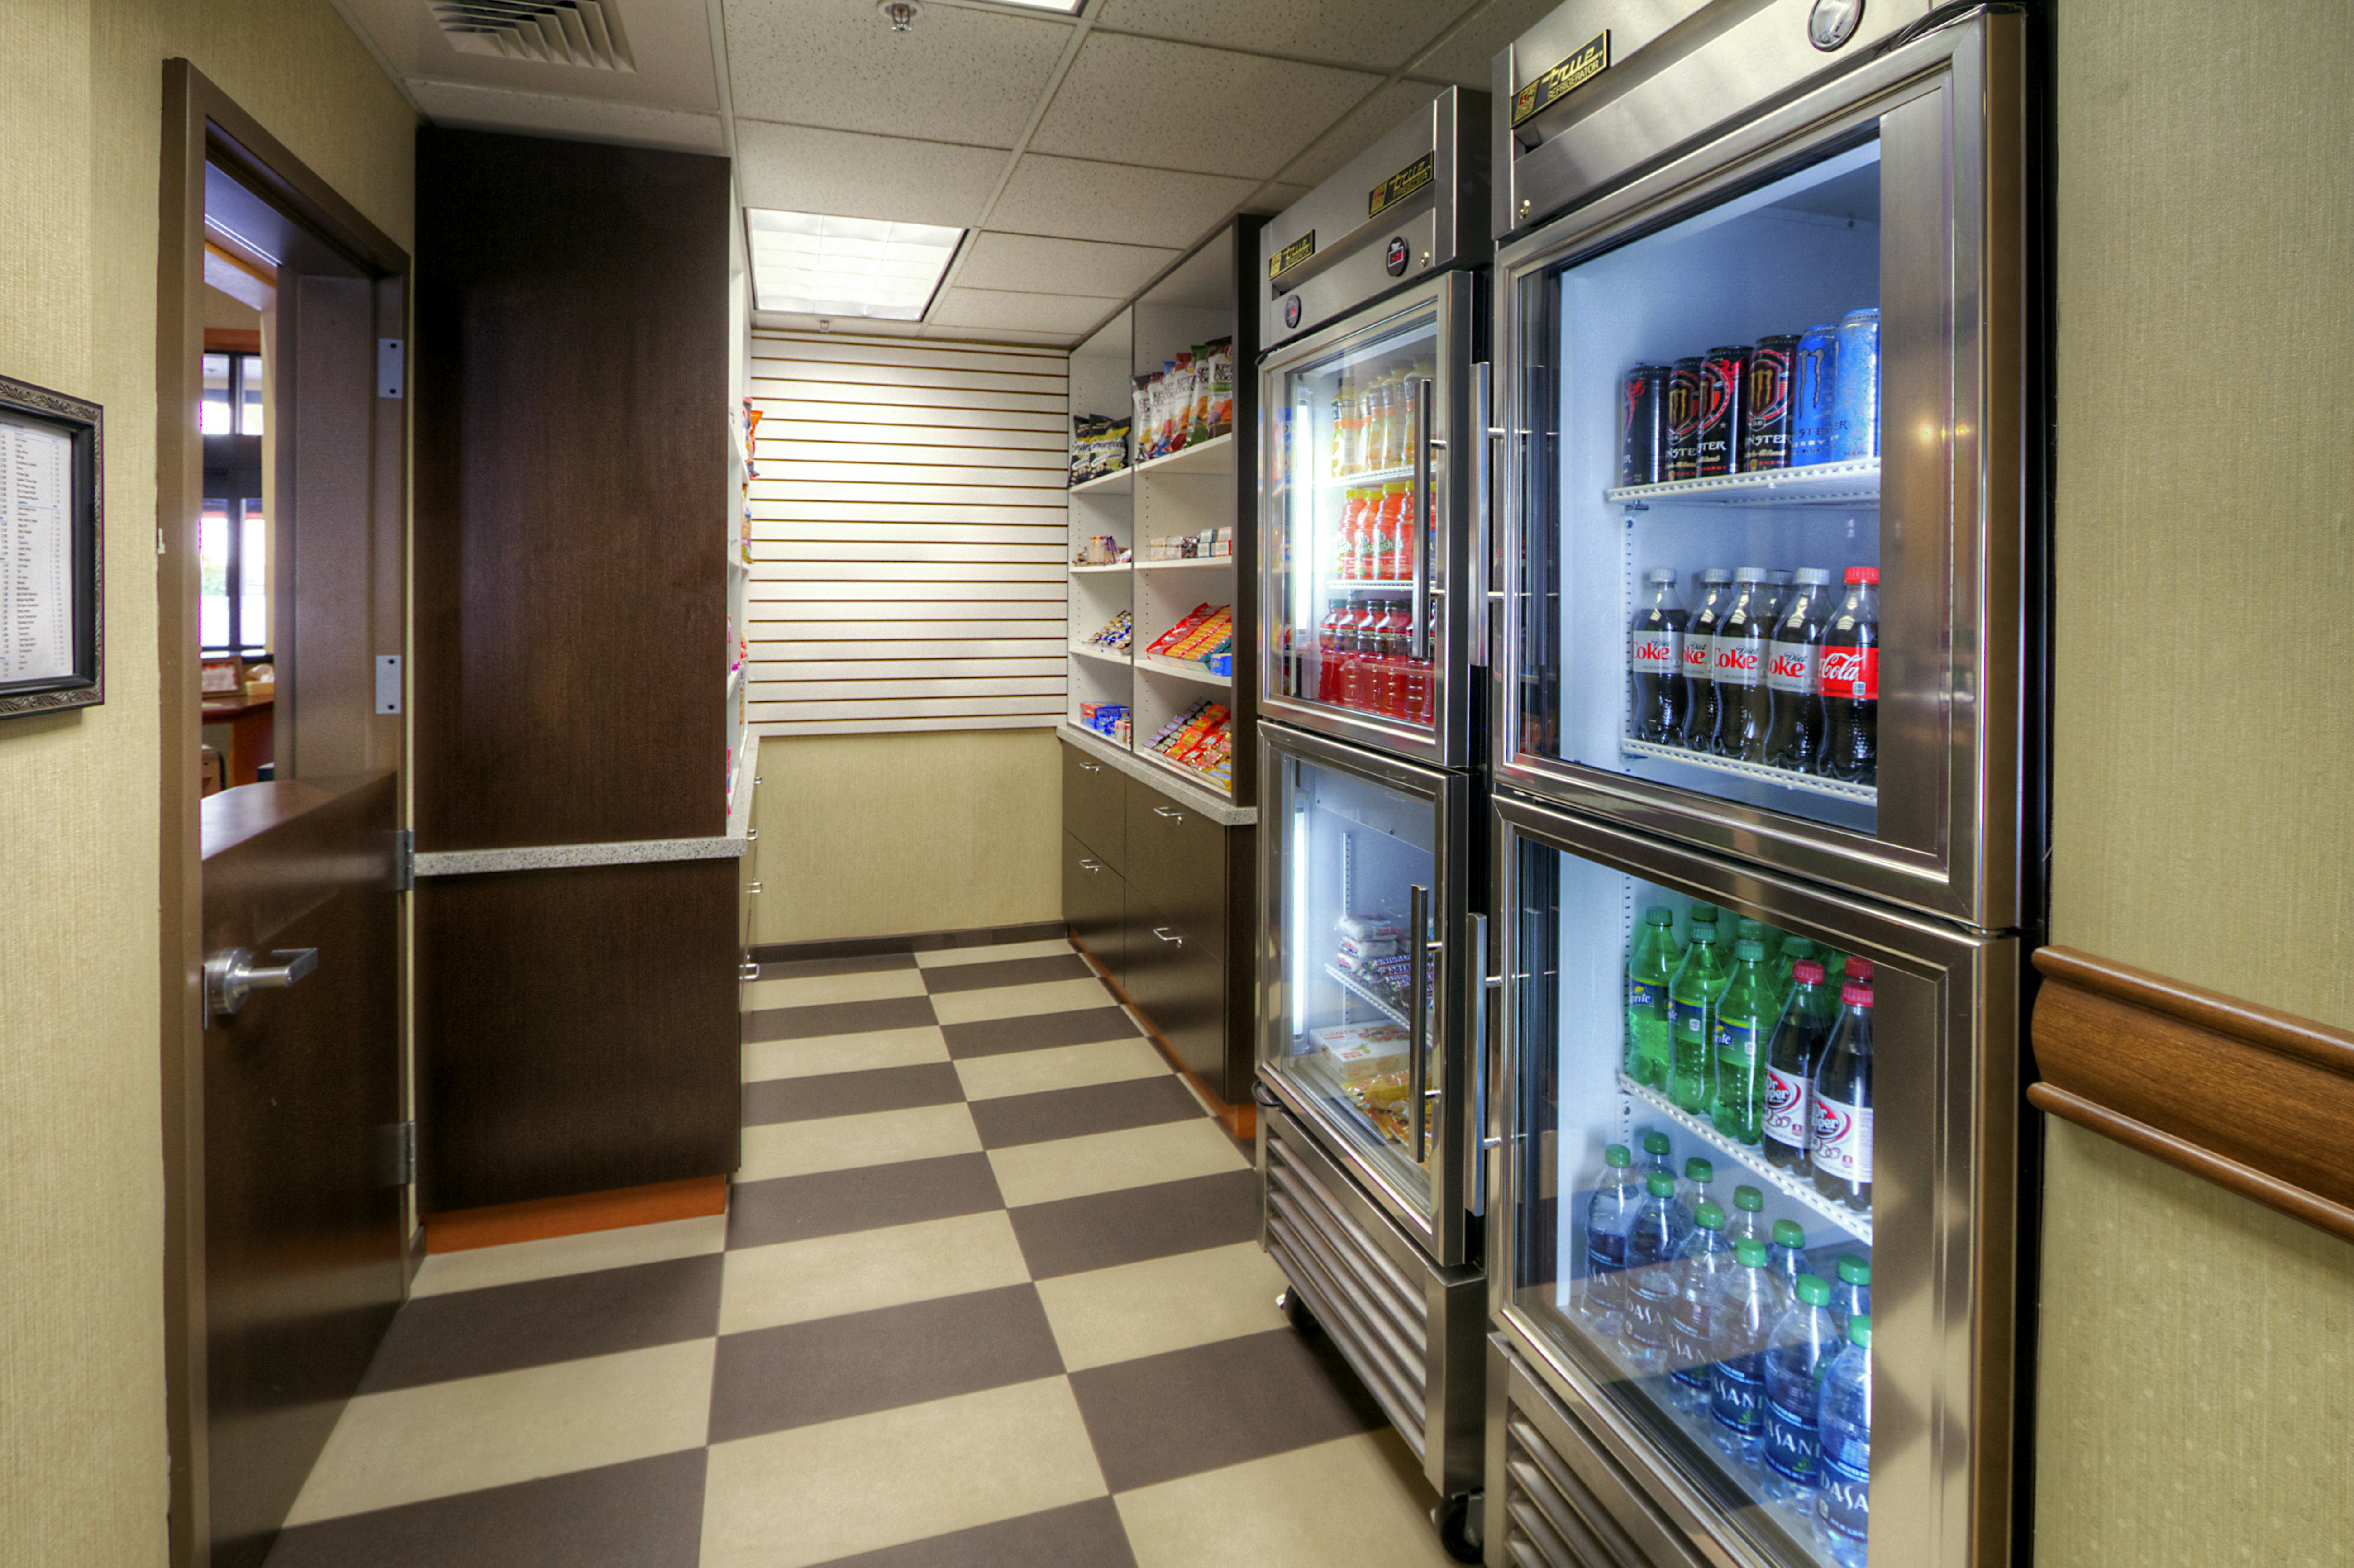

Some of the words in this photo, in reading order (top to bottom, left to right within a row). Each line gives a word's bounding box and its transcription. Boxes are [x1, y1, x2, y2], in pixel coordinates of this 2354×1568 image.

[1542, 46, 1599, 91] true
[1548, 59, 1599, 100] REFRIGERATOR
[1698, 441, 1726, 453] STER
[1745, 434, 1792, 447] NSTER
[1665, 447, 1696, 458] NSTE
[1714, 647, 1758, 670] Coke
[1769, 655, 1806, 678] oke
[1822, 653, 1866, 681] Cola
[1766, 1089, 1790, 1103] pper
[1820, 1470, 1869, 1513] DASA
